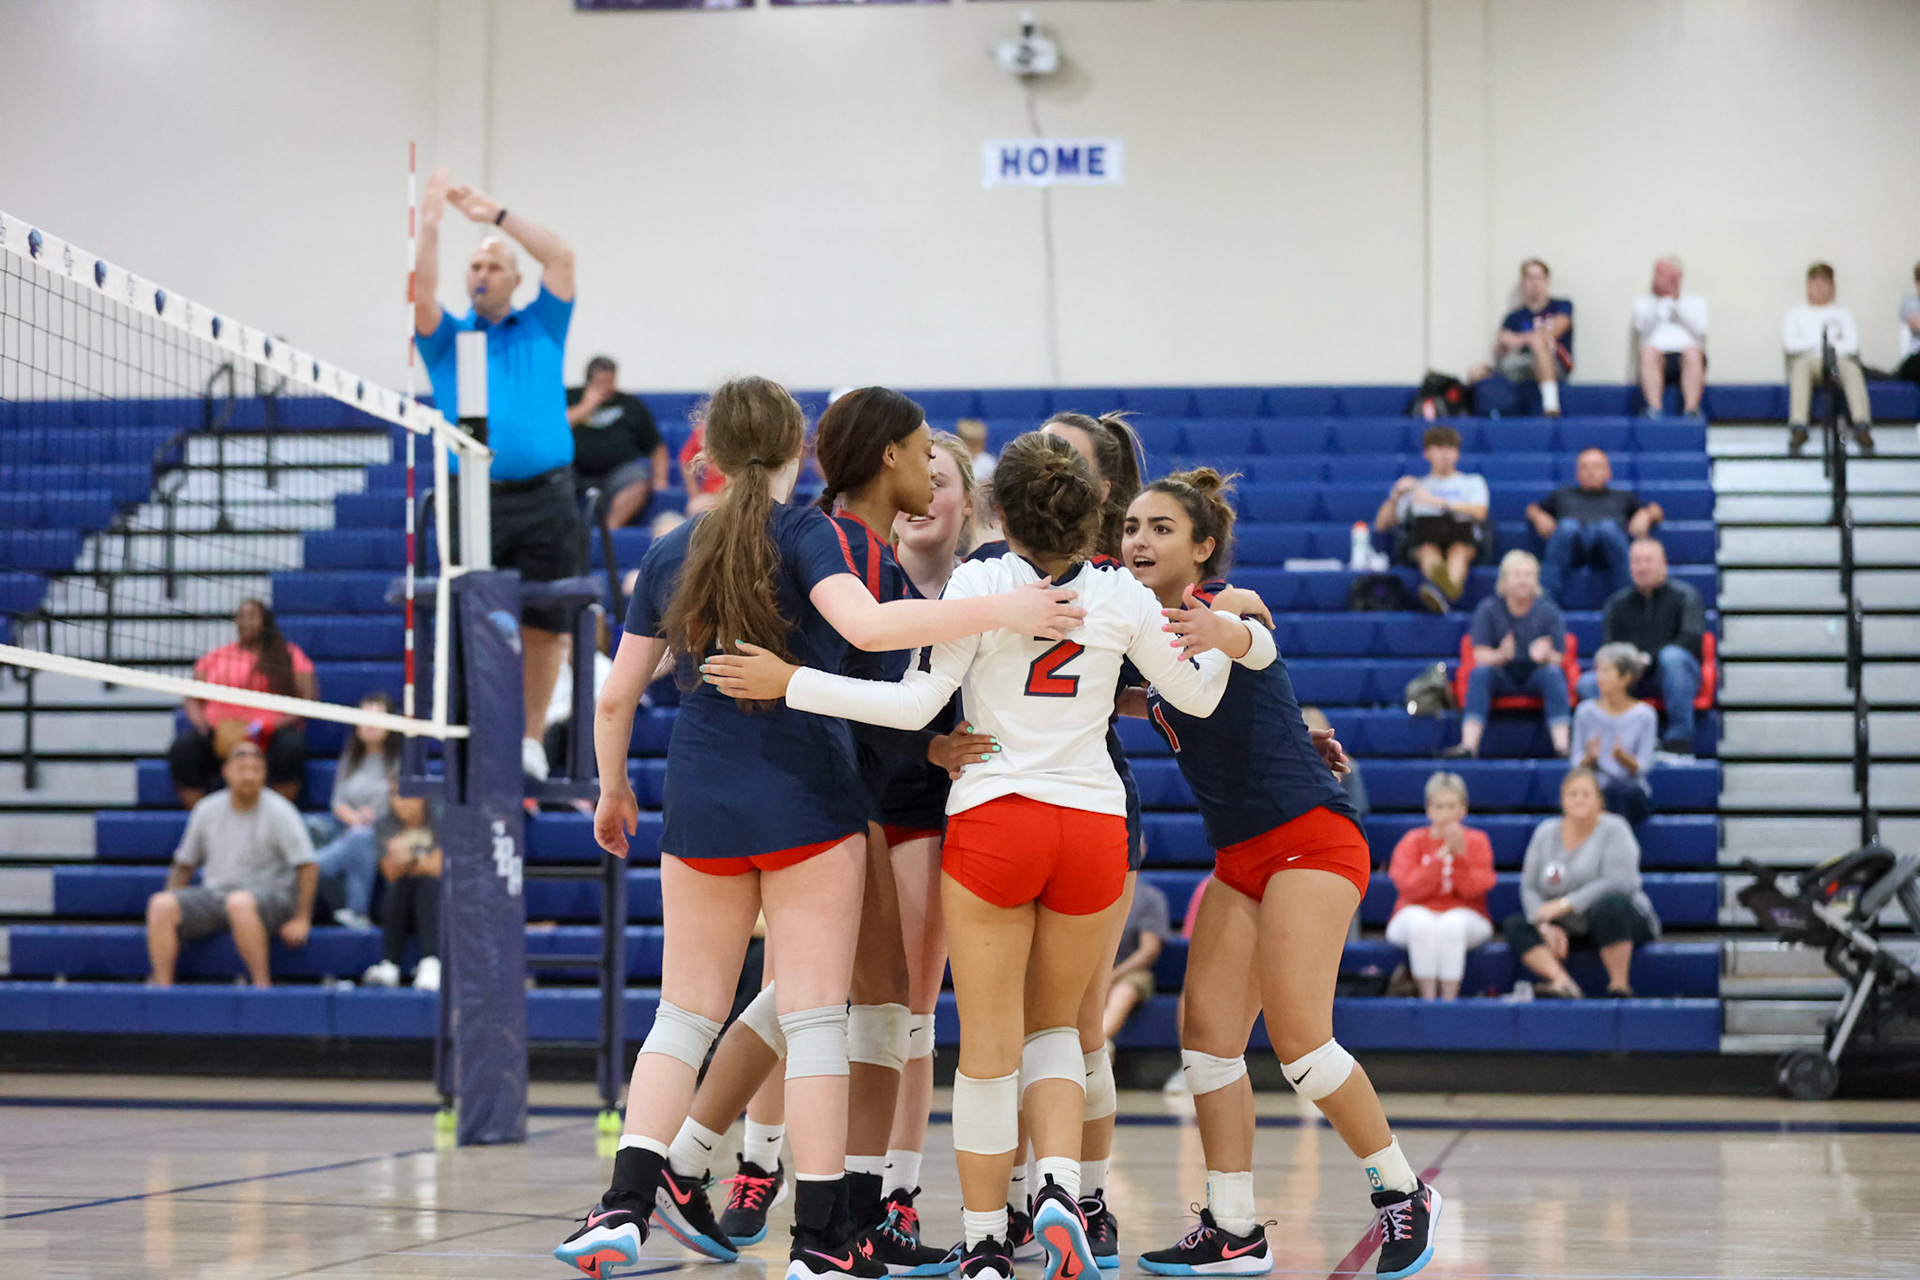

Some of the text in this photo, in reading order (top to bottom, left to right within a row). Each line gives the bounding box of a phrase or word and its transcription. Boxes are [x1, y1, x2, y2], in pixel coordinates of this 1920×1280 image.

[1001, 147, 1105, 176] HOME
[1024, 635, 1085, 697] 2
[1152, 702, 1181, 753] 1
